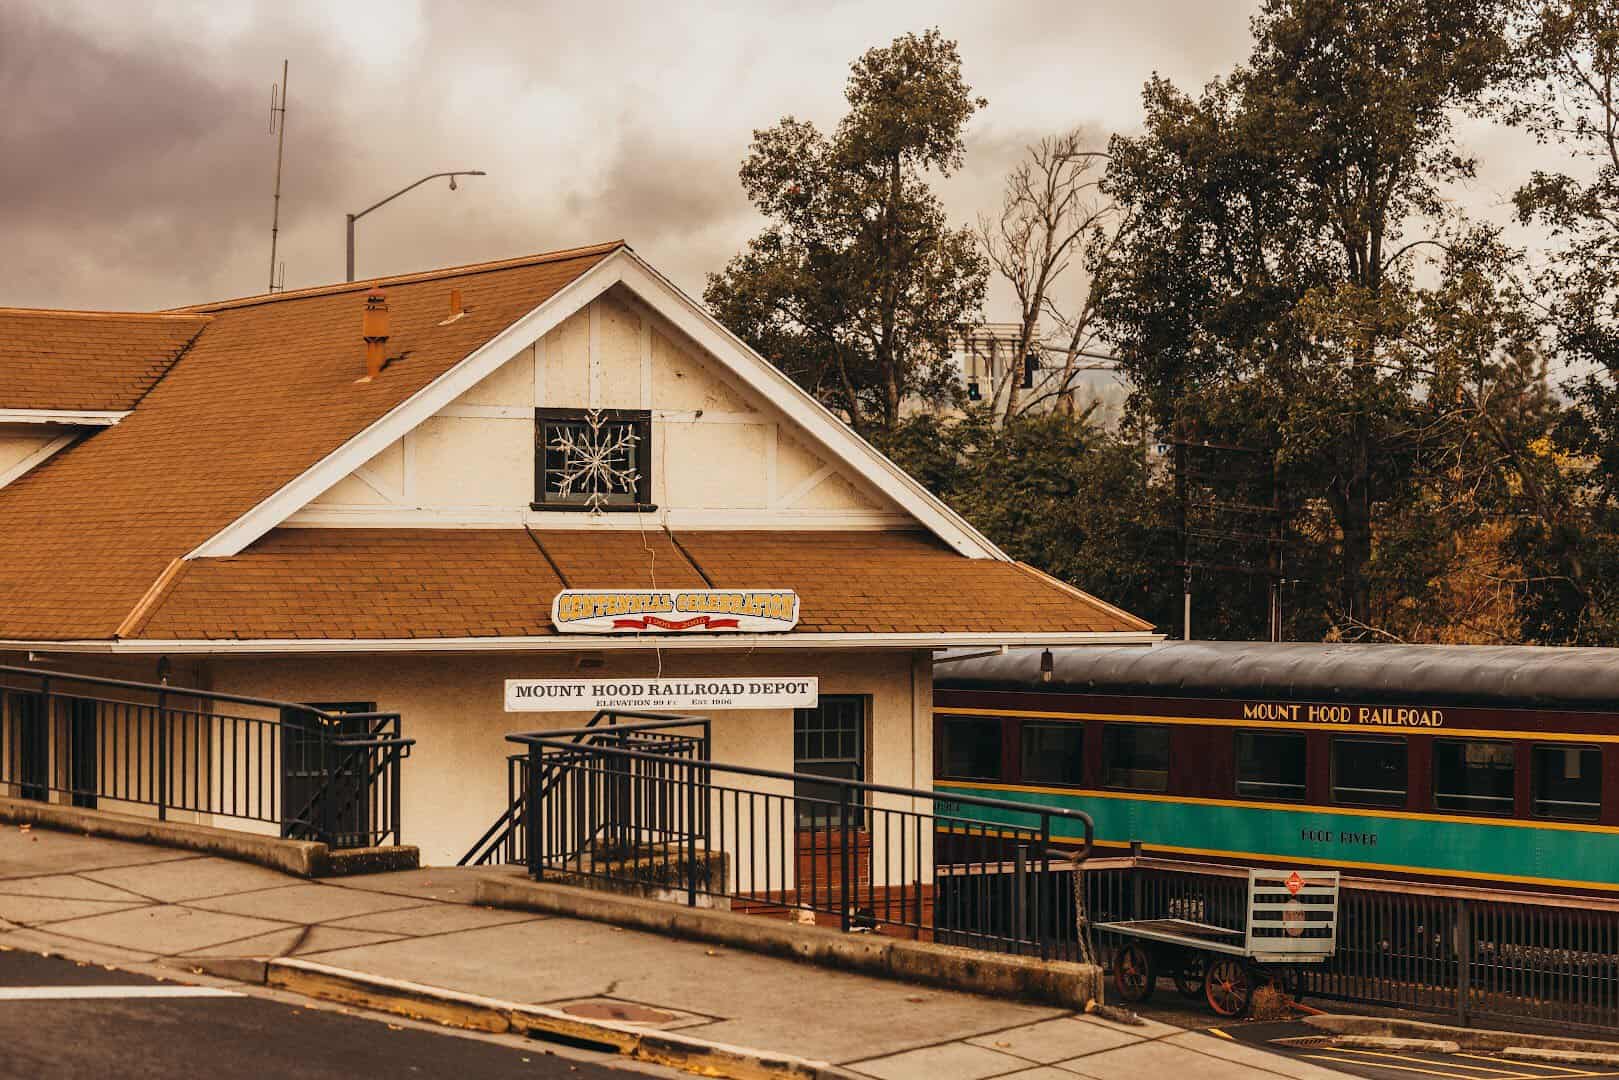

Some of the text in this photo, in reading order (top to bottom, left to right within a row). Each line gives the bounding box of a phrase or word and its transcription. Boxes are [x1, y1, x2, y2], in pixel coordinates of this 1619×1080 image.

[558, 593, 796, 622] CENTENNIAL CELEBRATION
[516, 682, 809, 698] MOUNT HOOD RAILROAD DEPOT
[596, 699, 650, 707] ELEVATION
[1243, 704, 1443, 727] MOUNT HOOD RAILROAD
[1302, 829, 1377, 846] HOOD RIVER
